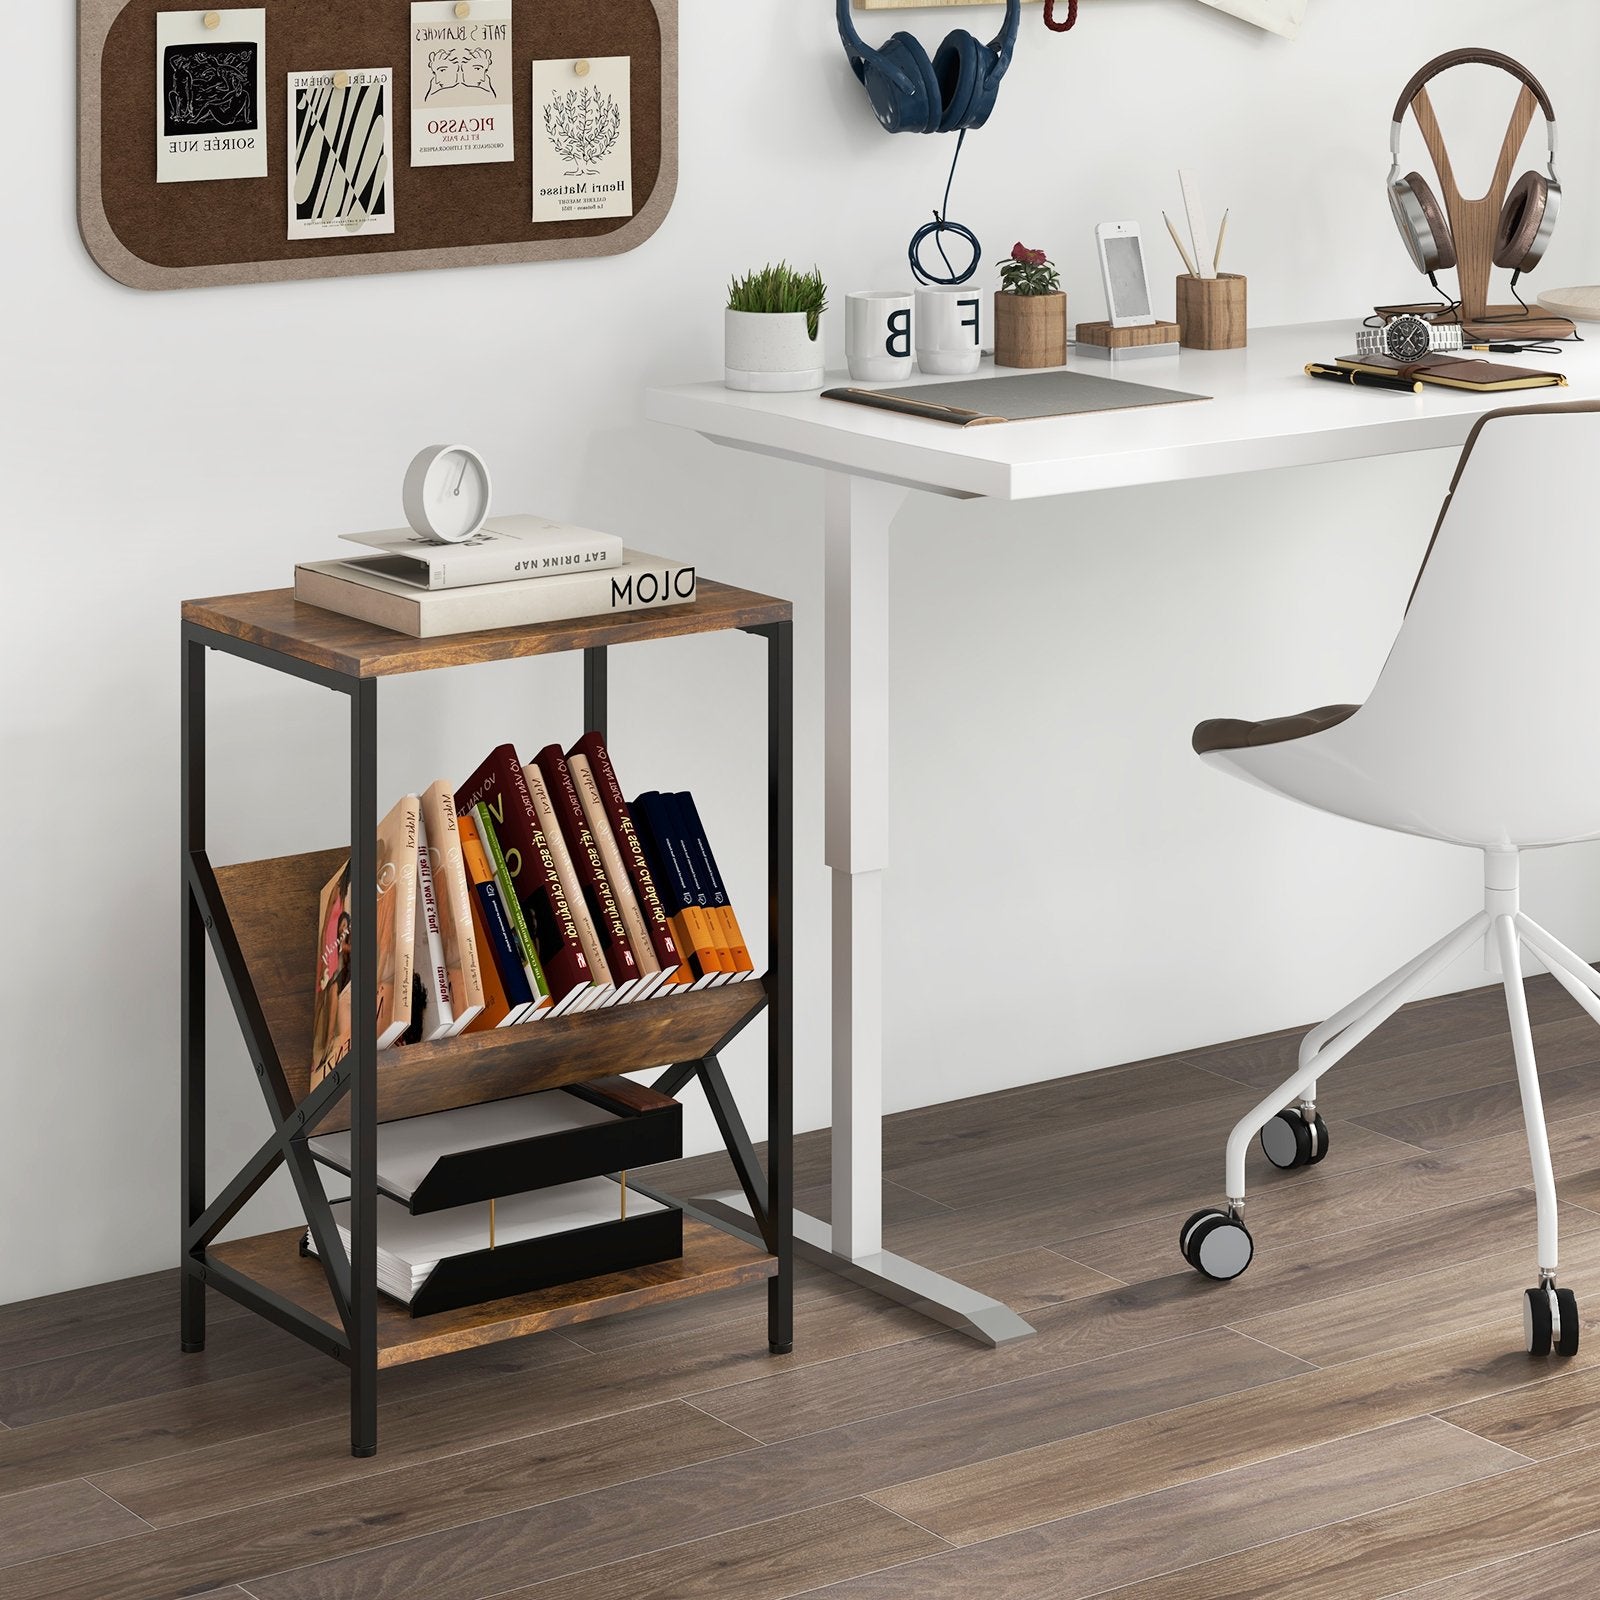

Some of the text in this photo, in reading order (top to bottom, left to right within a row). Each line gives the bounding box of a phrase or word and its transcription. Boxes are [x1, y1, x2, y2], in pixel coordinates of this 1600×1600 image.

[514, 551, 606, 571] EAT DRINK NAP
